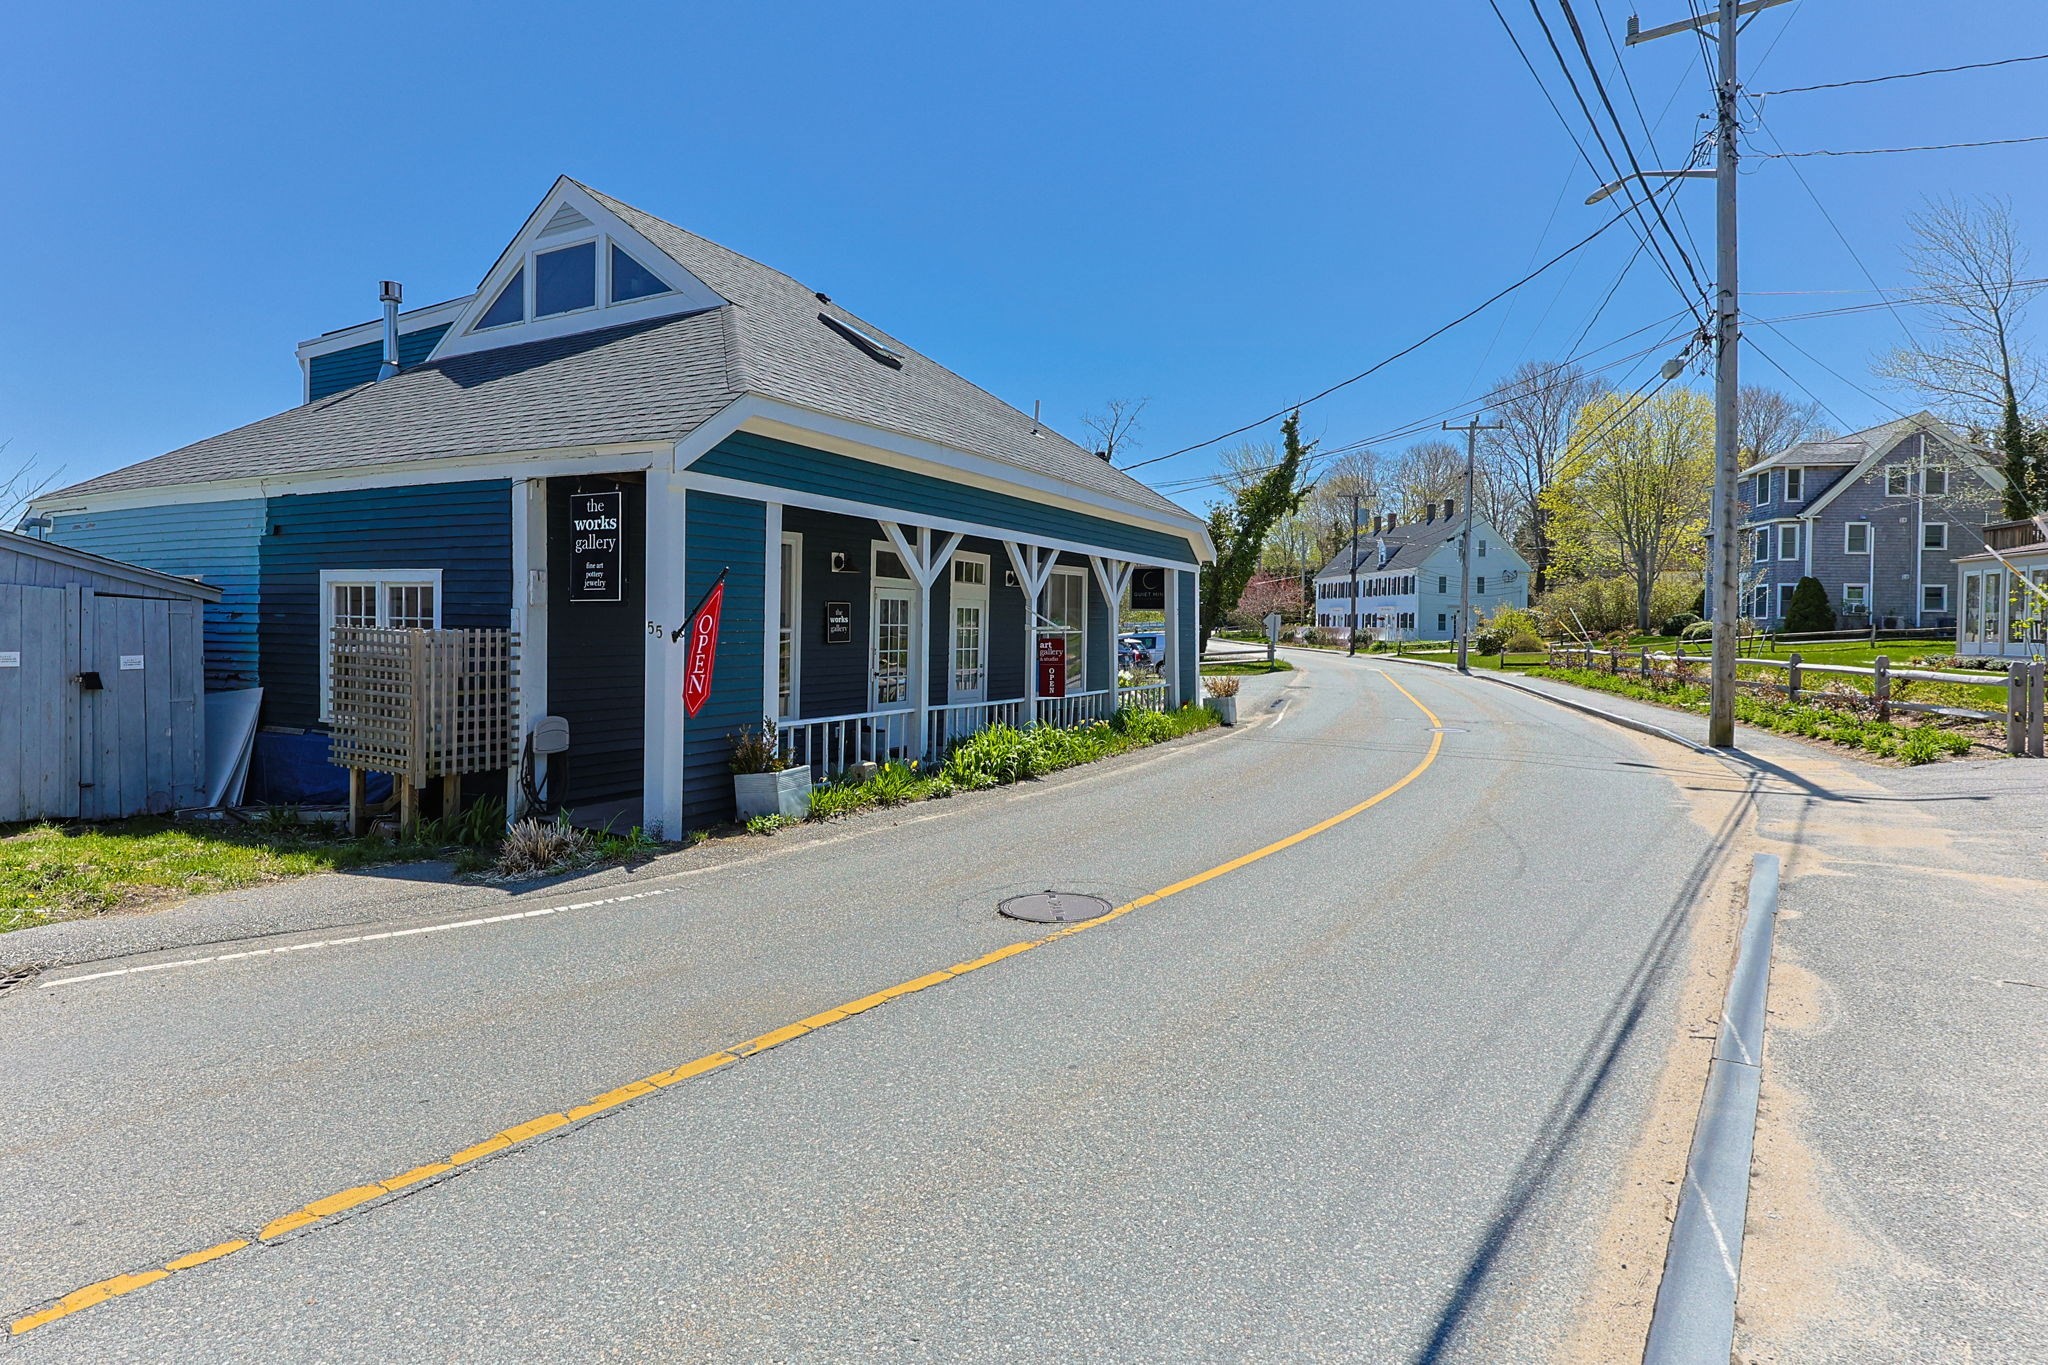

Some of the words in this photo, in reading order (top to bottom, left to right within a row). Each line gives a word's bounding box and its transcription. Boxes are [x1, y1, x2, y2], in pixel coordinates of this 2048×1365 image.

[586, 498, 605, 513] the
[574, 515, 617, 531] works
[575, 533, 617, 554] gallery
[585, 571, 604, 579] pottery
[584, 579, 606, 589] jewelry
[830, 615, 849, 624] works
[647, 621, 663, 639] 55
[1039, 641, 1053, 649] art
[688, 614, 713, 694] OPEN
[1039, 648, 1064, 657] gallery
